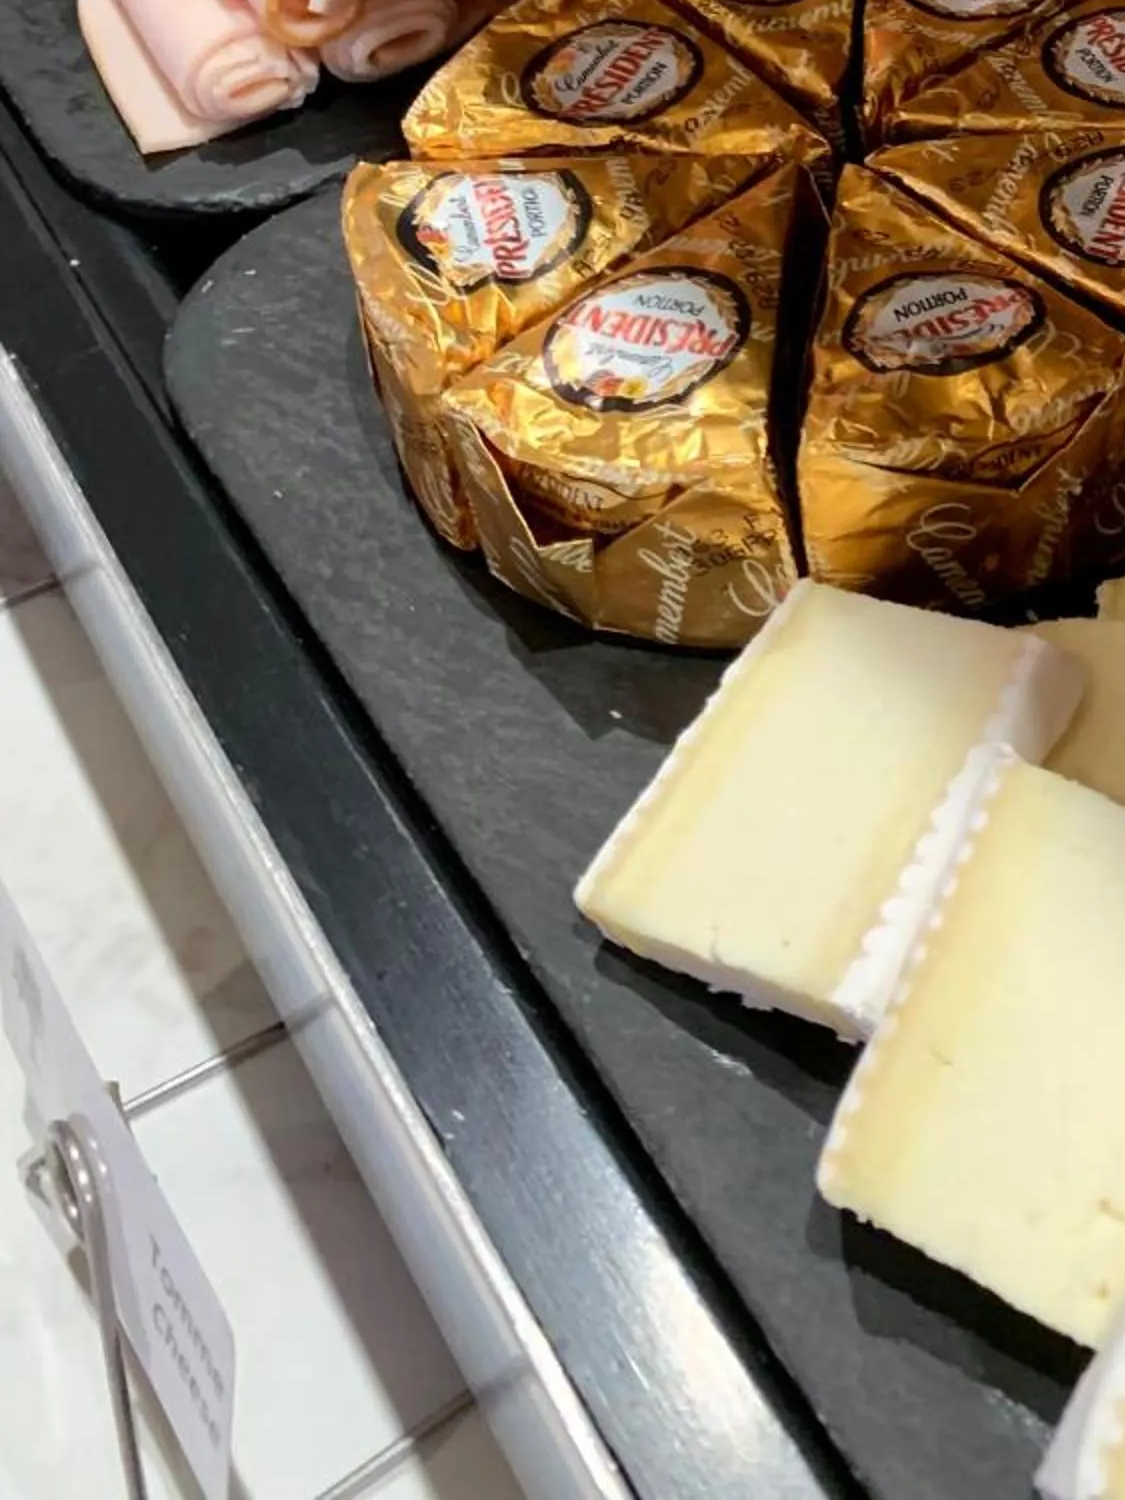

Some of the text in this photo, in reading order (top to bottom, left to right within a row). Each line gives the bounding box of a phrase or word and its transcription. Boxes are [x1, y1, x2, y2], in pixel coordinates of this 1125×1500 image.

[555, 40, 619, 92] Camembert
[565, 27, 665, 117] PRÉSIDENT
[621, 63, 667, 104] PORTION
[1076, 49, 1114, 83] PORTION
[521, 185, 547, 239] PORTIO
[1081, 175, 1114, 218] PORTION
[565, 303, 738, 357] PRÉSIDENT
[636, 294, 706, 316] PORTION
[894, 287, 969, 321] PORTION
[638, 521, 697, 644] membert
[152, 1303, 221, 1448] Cheese
